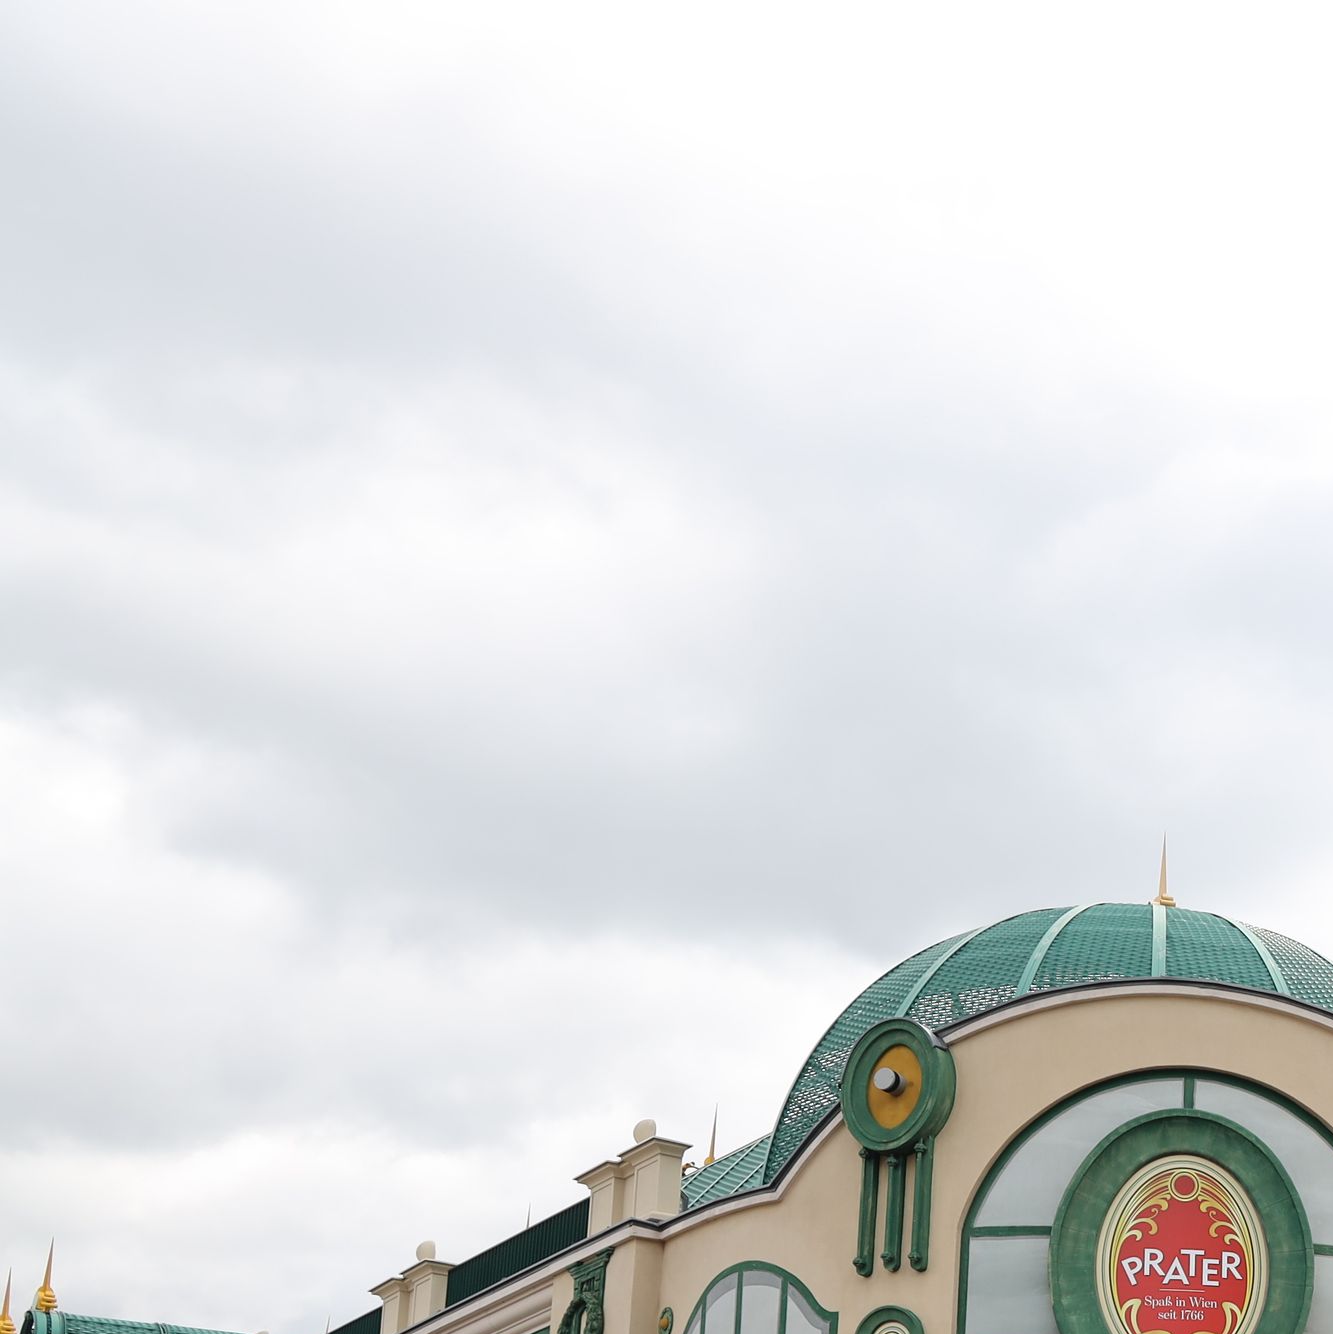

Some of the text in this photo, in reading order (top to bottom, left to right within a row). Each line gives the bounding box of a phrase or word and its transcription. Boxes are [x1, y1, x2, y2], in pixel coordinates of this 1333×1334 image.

[1120, 1248, 1243, 1287] PRATER
[1144, 1295, 1218, 1308] Spaß in Wien
[1158, 1309, 1204, 1321] seit 1766
